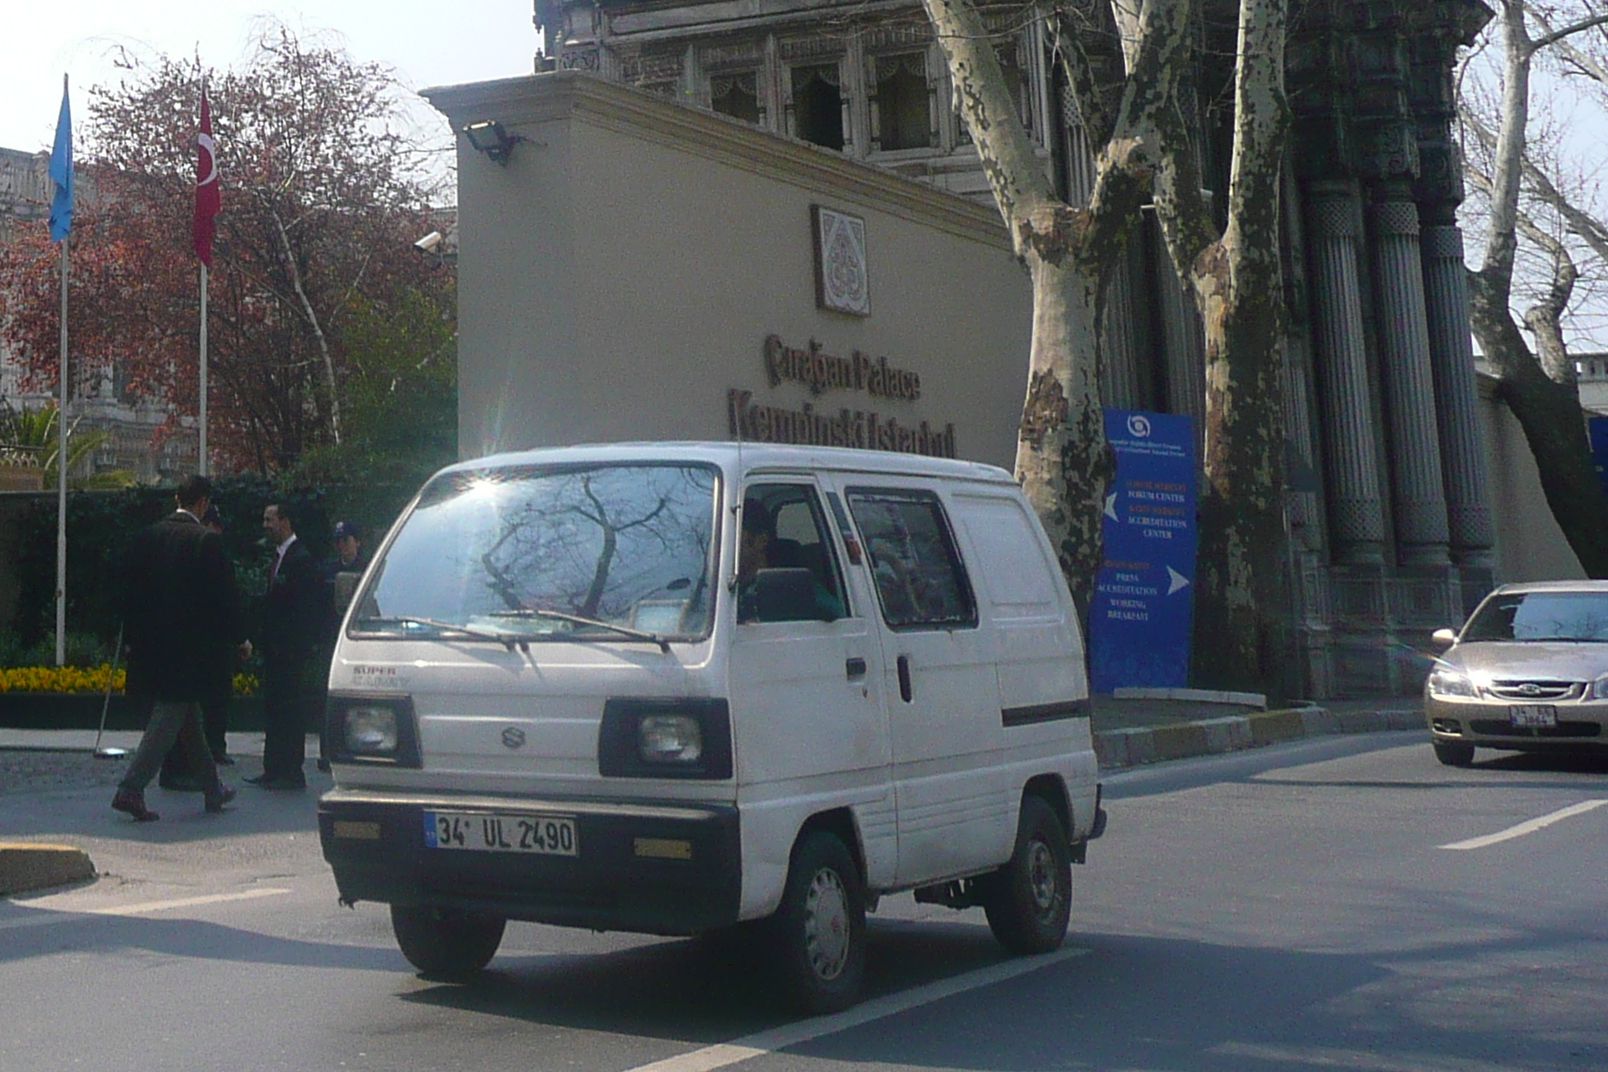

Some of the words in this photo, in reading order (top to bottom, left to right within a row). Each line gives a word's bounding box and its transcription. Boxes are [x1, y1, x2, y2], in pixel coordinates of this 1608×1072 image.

[852, 349, 922, 401] Palace
[353, 665, 396, 676] SUPER
[438, 816, 465, 846] 34
[482, 818, 512, 849] UL
[518, 820, 573, 852] 2490
